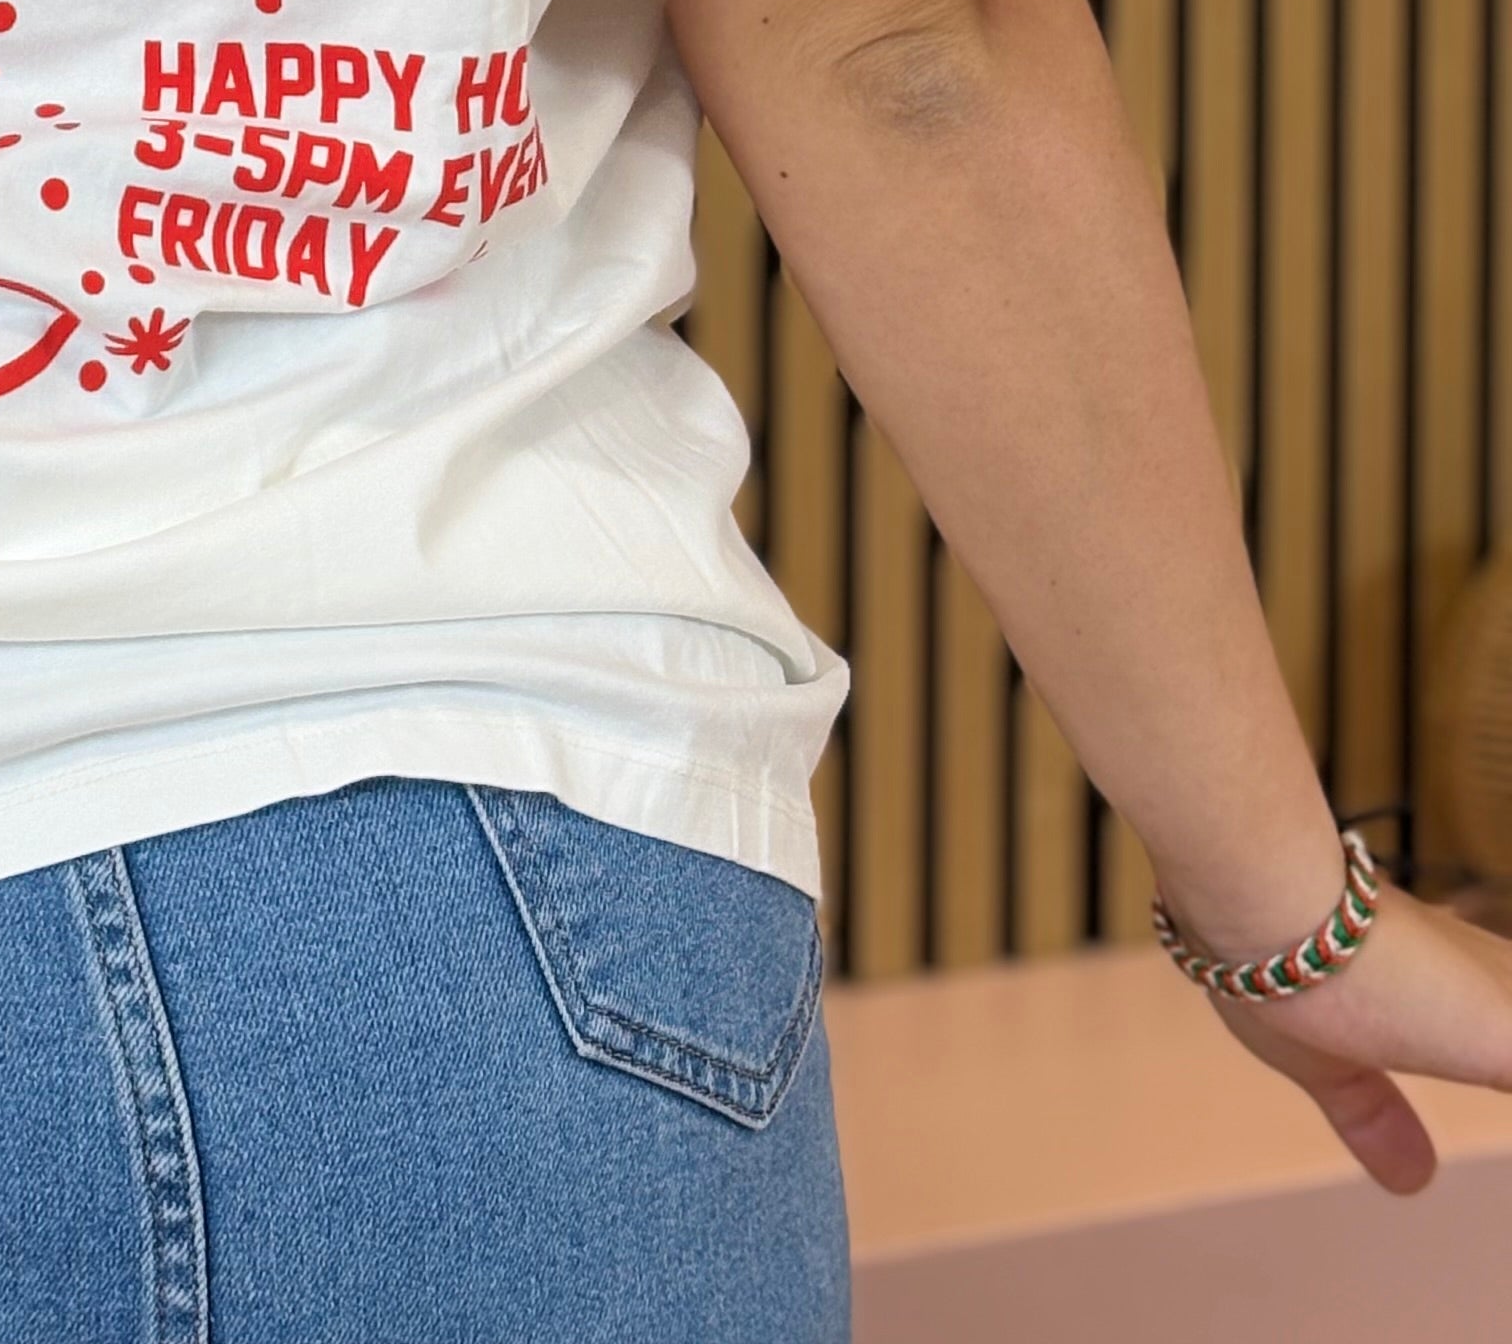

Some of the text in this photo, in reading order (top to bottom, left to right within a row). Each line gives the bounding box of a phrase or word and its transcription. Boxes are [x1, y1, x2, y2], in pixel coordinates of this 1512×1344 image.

[142, 40, 531, 134] HAPPY HO
[134, 117, 413, 214] 3-5PM
[118, 185, 399, 307] FRIDAY
